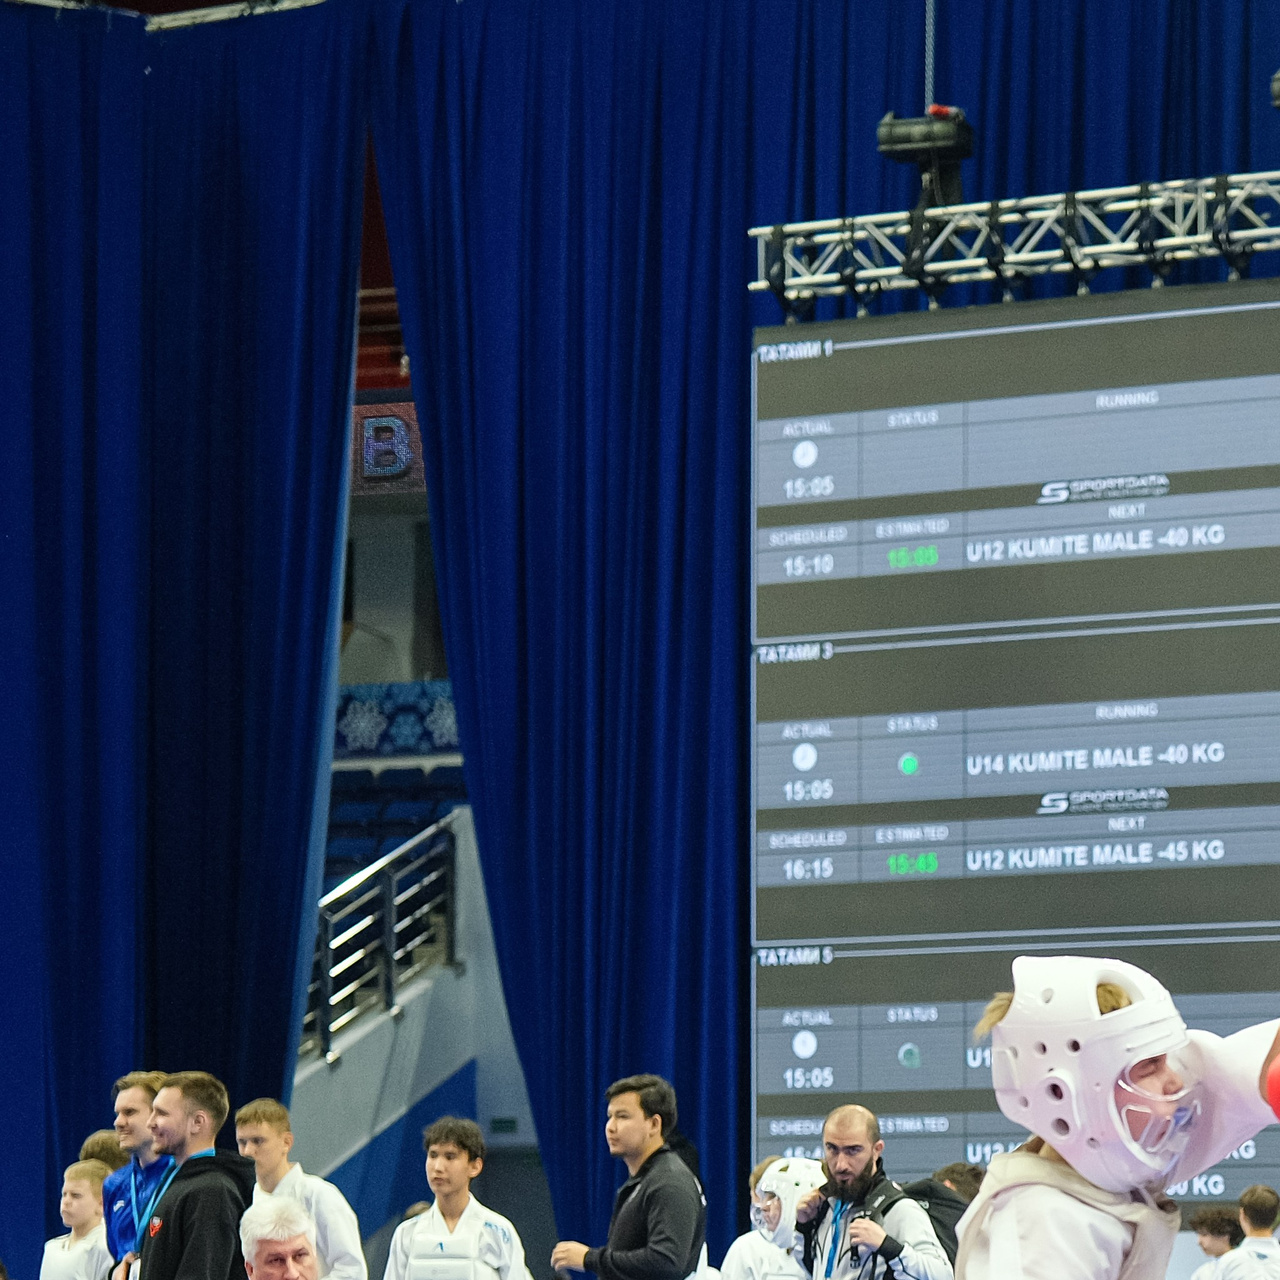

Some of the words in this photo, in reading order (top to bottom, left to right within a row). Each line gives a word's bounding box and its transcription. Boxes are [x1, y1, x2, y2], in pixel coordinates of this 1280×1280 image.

[824, 340, 833, 357] 1
[966, 541, 1005, 562] U12
[1008, 534, 1089, 559] KUMITE
[1092, 529, 1153, 552] MALE
[1192, 525, 1225, 545] KG
[783, 554, 834, 577] 15:10
[823, 642, 833, 659] 3
[967, 754, 1004, 775] U14
[1008, 749, 1088, 773] KUMITE
[1092, 745, 1153, 769] MALE
[1158, 744, 1187, 765] -40
[1192, 742, 1224, 763] KG
[784, 779, 833, 801] 15:05
[1108, 816, 1146, 832] NEXT
[967, 850, 1004, 871] U12
[1008, 845, 1088, 870] KUMITE
[1092, 842, 1153, 866] MALE
[1158, 840, 1188, 862] -45
[1192, 839, 1224, 860] KG
[784, 857, 833, 880] 16:15
[782, 1010, 834, 1026] ACTUAL
[886, 1007, 938, 1022] STATUS
[967, 1047, 991, 1068] U1
[783, 1066, 834, 1088] 15:05
[770, 1120, 823, 1135] SCHEDU
[1192, 1174, 1226, 1195] KG
